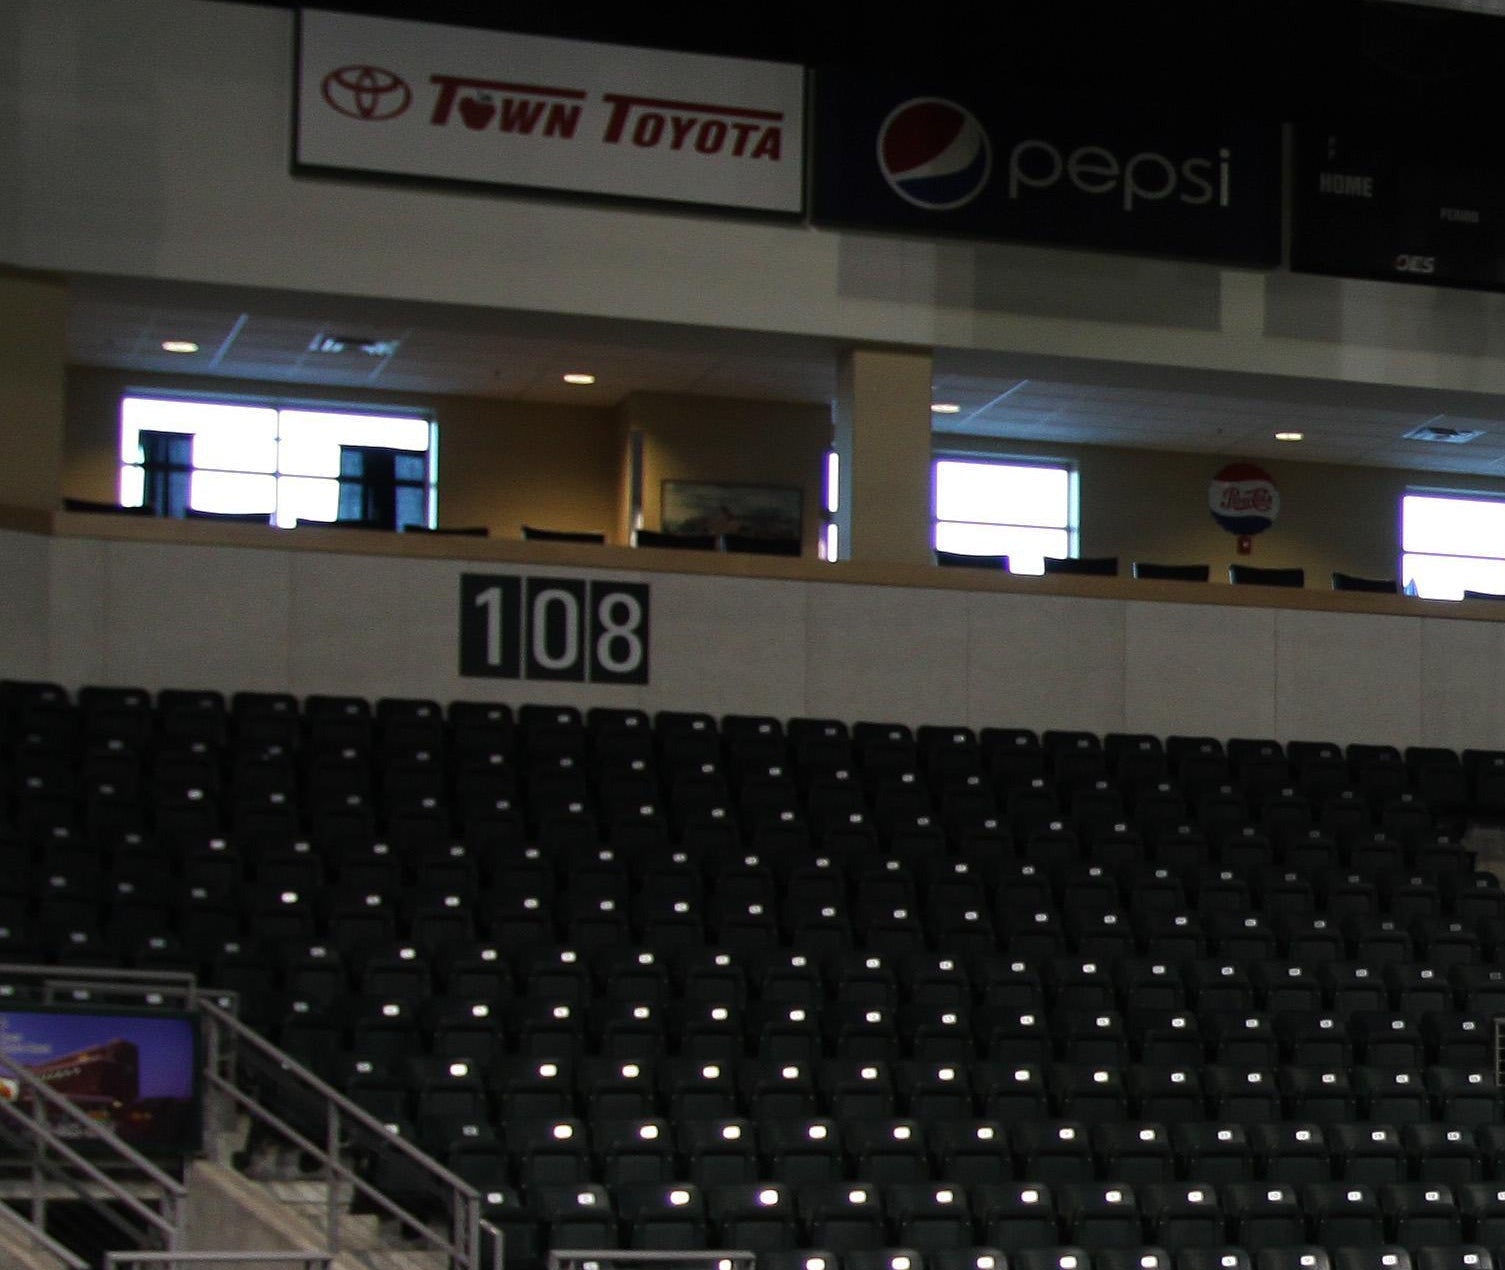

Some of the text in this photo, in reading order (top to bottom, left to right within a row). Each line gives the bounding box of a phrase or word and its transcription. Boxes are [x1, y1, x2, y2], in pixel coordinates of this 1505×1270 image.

[603, 94, 784, 161] TOYOTA
[1010, 138, 1230, 211] pepsi
[474, 588, 643, 674] 108
